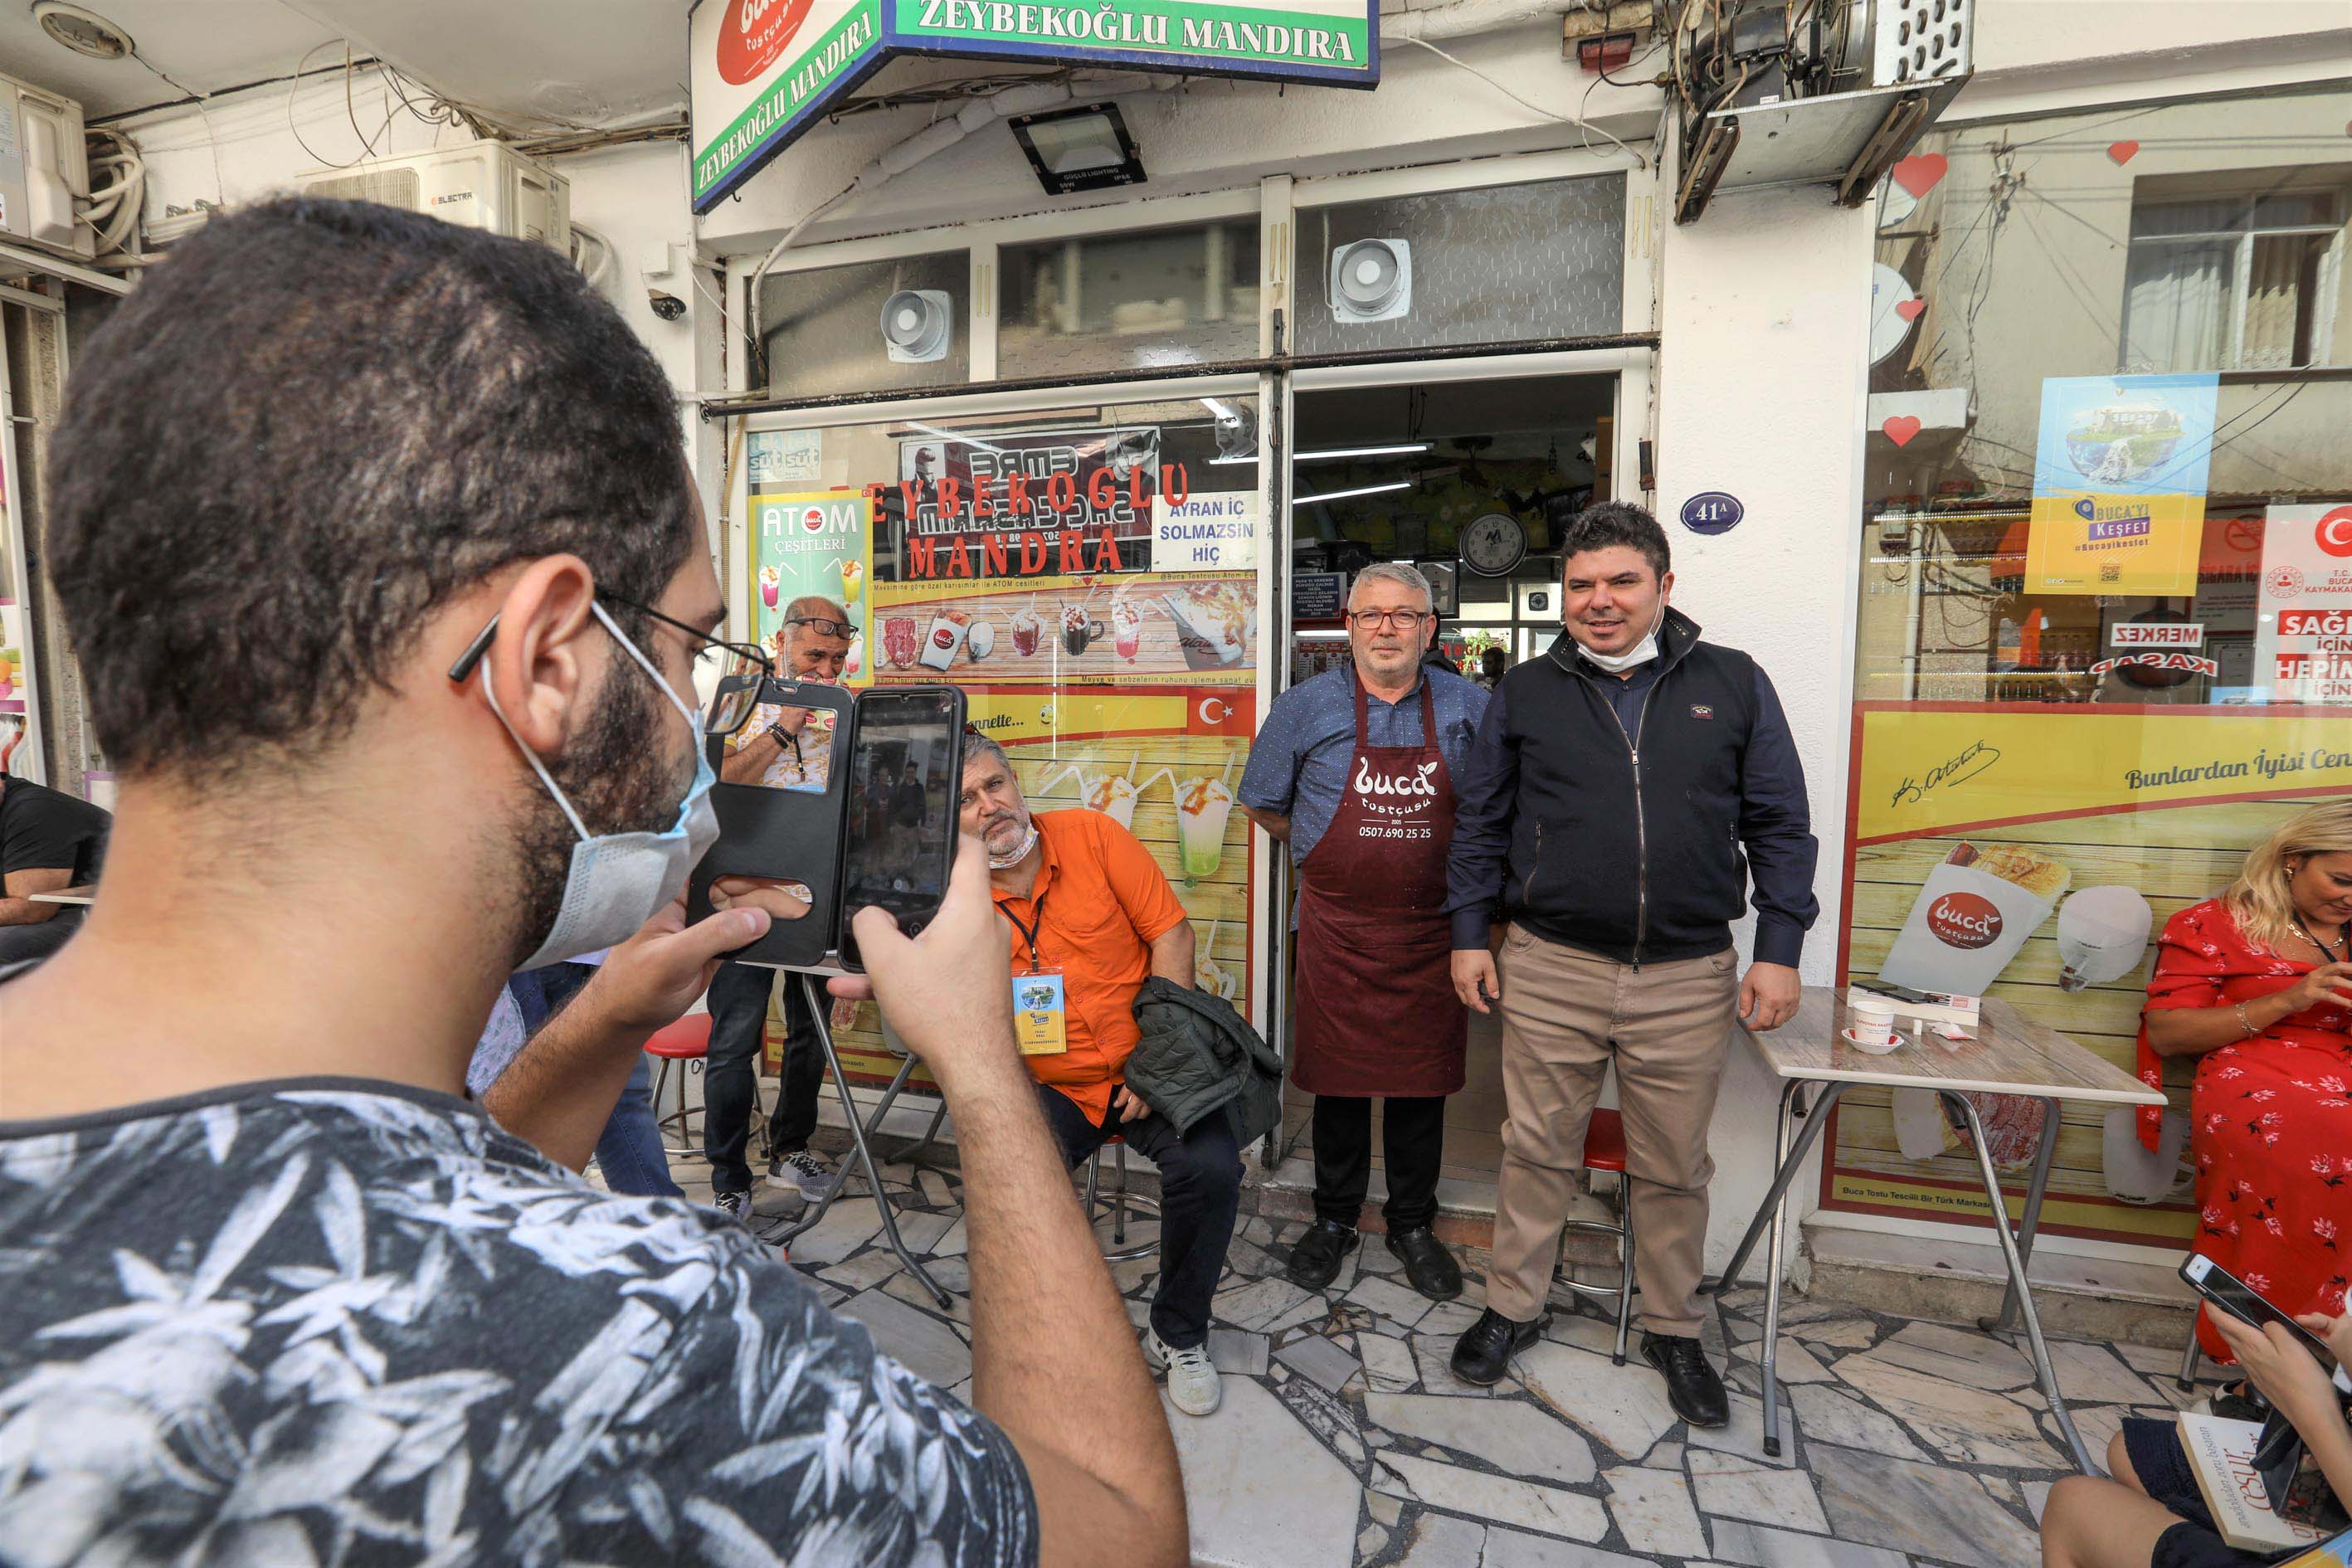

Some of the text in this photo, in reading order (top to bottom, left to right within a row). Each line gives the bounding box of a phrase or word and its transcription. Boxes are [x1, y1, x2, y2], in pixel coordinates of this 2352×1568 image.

[918, 0, 1356, 61] ZEYBEKOĞLU MANDIRA
[699, 11, 873, 191] ZEYBEKOĞLU MANDIRA
[1088, 167, 1119, 178] LIGHTING
[438, 192, 473, 204] ELECTRA
[830, 462, 1188, 526] EYBEKOGLU
[1170, 496, 1244, 519] AYRAN İÇ
[2096, 503, 2150, 521] BUCA'YI
[763, 503, 857, 537] ATOM
[2096, 521, 2148, 537] KEŞFET
[1160, 523, 1254, 540] SOLMAZSIN
[774, 535, 847, 555] ÇEŞİTLERİ
[908, 527, 1123, 578] MANDRA
[1192, 543, 1220, 565] HİÇ
[1081, 675, 1104, 684] Meyve
[1353, 757, 1438, 796] buca
[2125, 760, 2249, 789] Bunlardan
[2252, 748, 2305, 779] İyisi
[1361, 796, 1431, 816] tostçusu
[1359, 826, 1431, 838] 0507.690 25 25
[1843, 1186, 1864, 1195] Buca
[1867, 1189, 1888, 1198] Tostu
[1892, 1191, 1919, 1201] Tescilli
[1920, 1194, 1932, 1202] Bir
[1936, 1195, 1954, 1205] Türk
[2223, 1449, 2273, 1511] cesur
